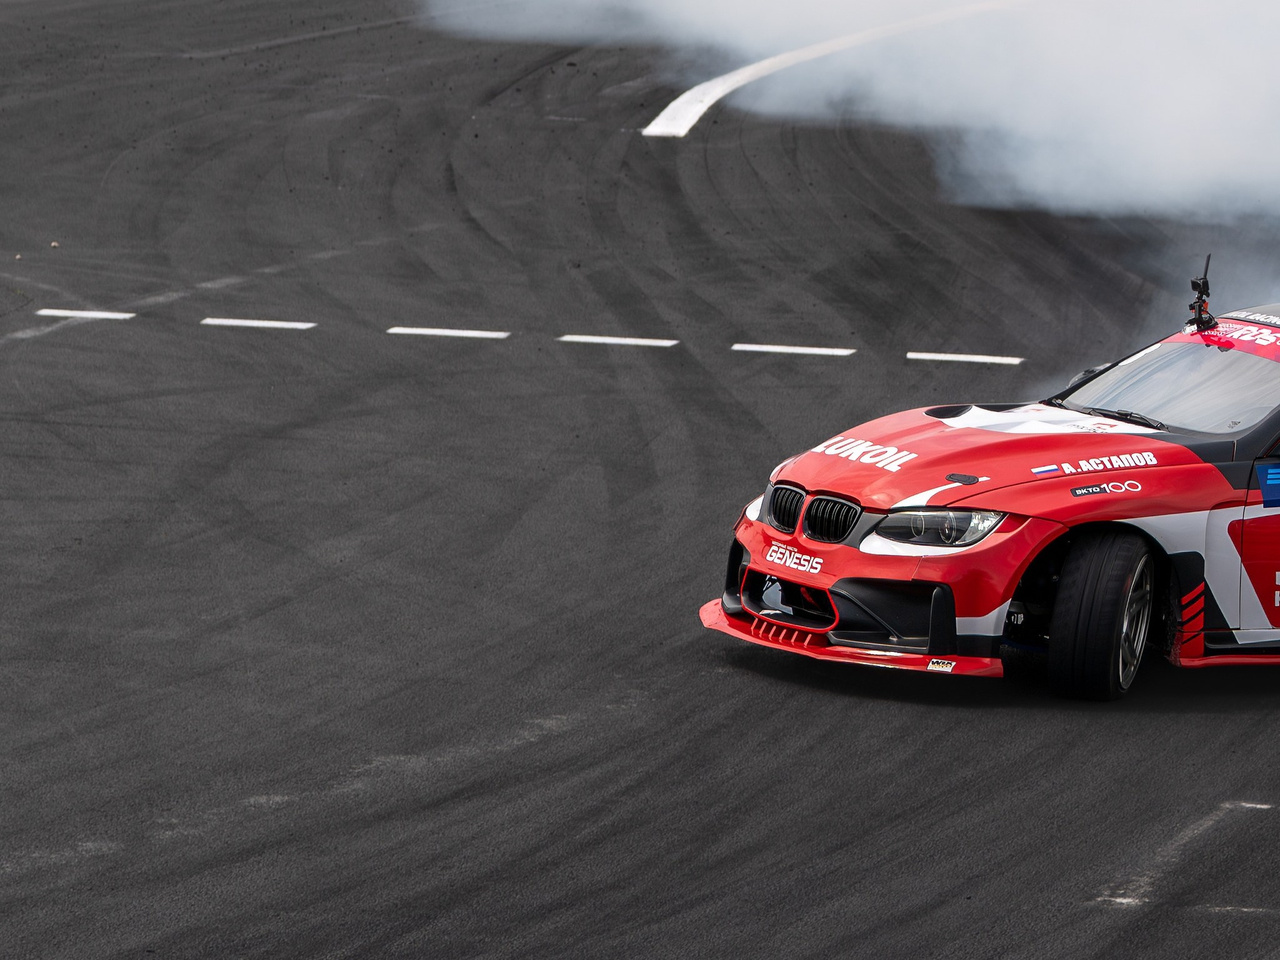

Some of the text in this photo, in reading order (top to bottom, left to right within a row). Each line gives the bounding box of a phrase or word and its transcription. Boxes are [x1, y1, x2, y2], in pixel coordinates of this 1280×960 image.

[810, 436, 919, 473] LUKOIL
[1060, 451, 1158, 474] А.АСТАПОВ
[765, 545, 824, 575] GENESIS
